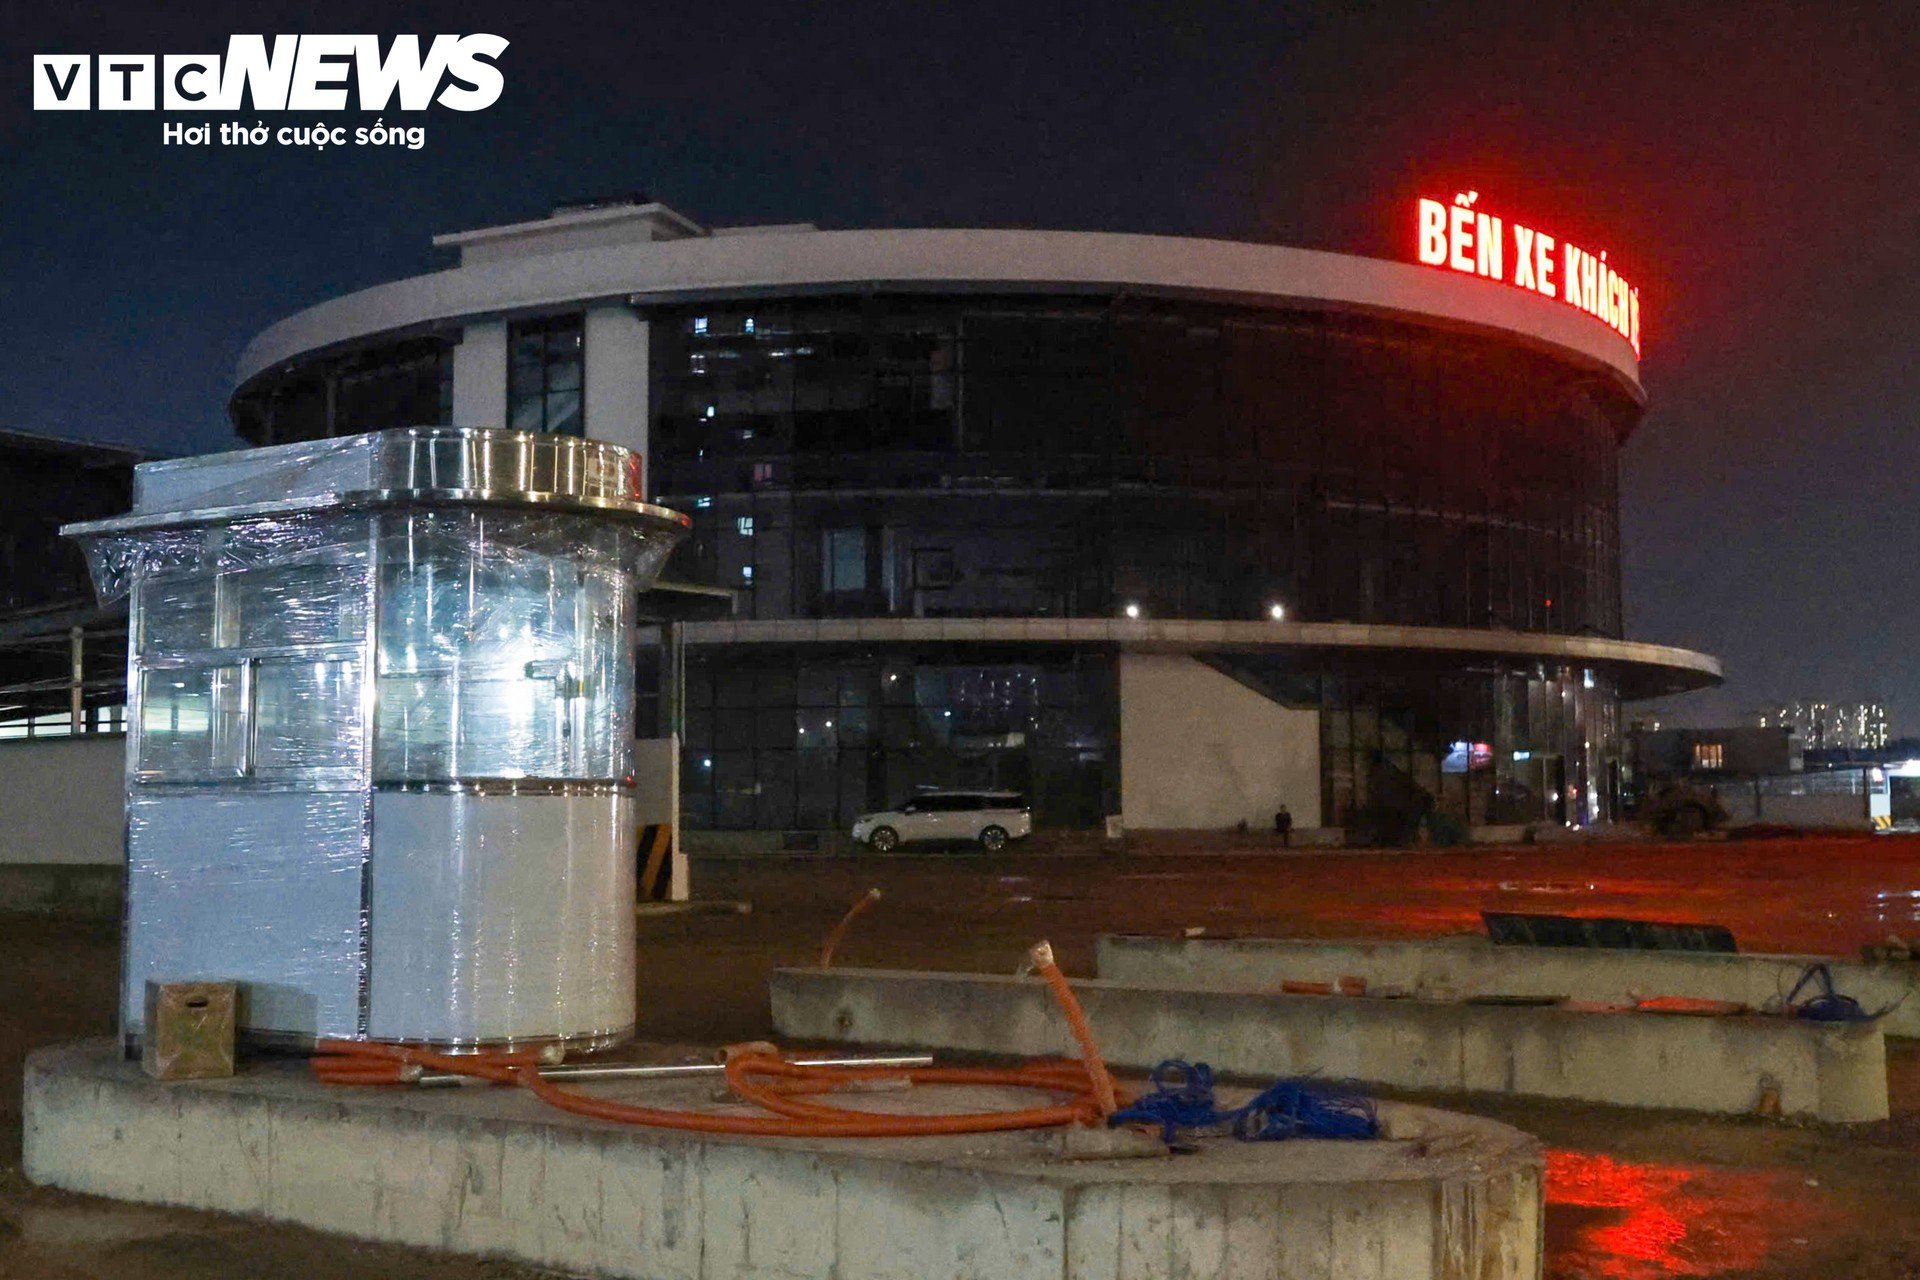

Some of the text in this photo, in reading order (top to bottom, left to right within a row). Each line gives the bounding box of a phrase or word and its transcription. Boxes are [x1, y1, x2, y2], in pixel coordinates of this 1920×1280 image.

[1418, 190, 1503, 281] BẾN
[1513, 224, 1556, 298] XE
[1564, 242, 1629, 338] KHÁCH
